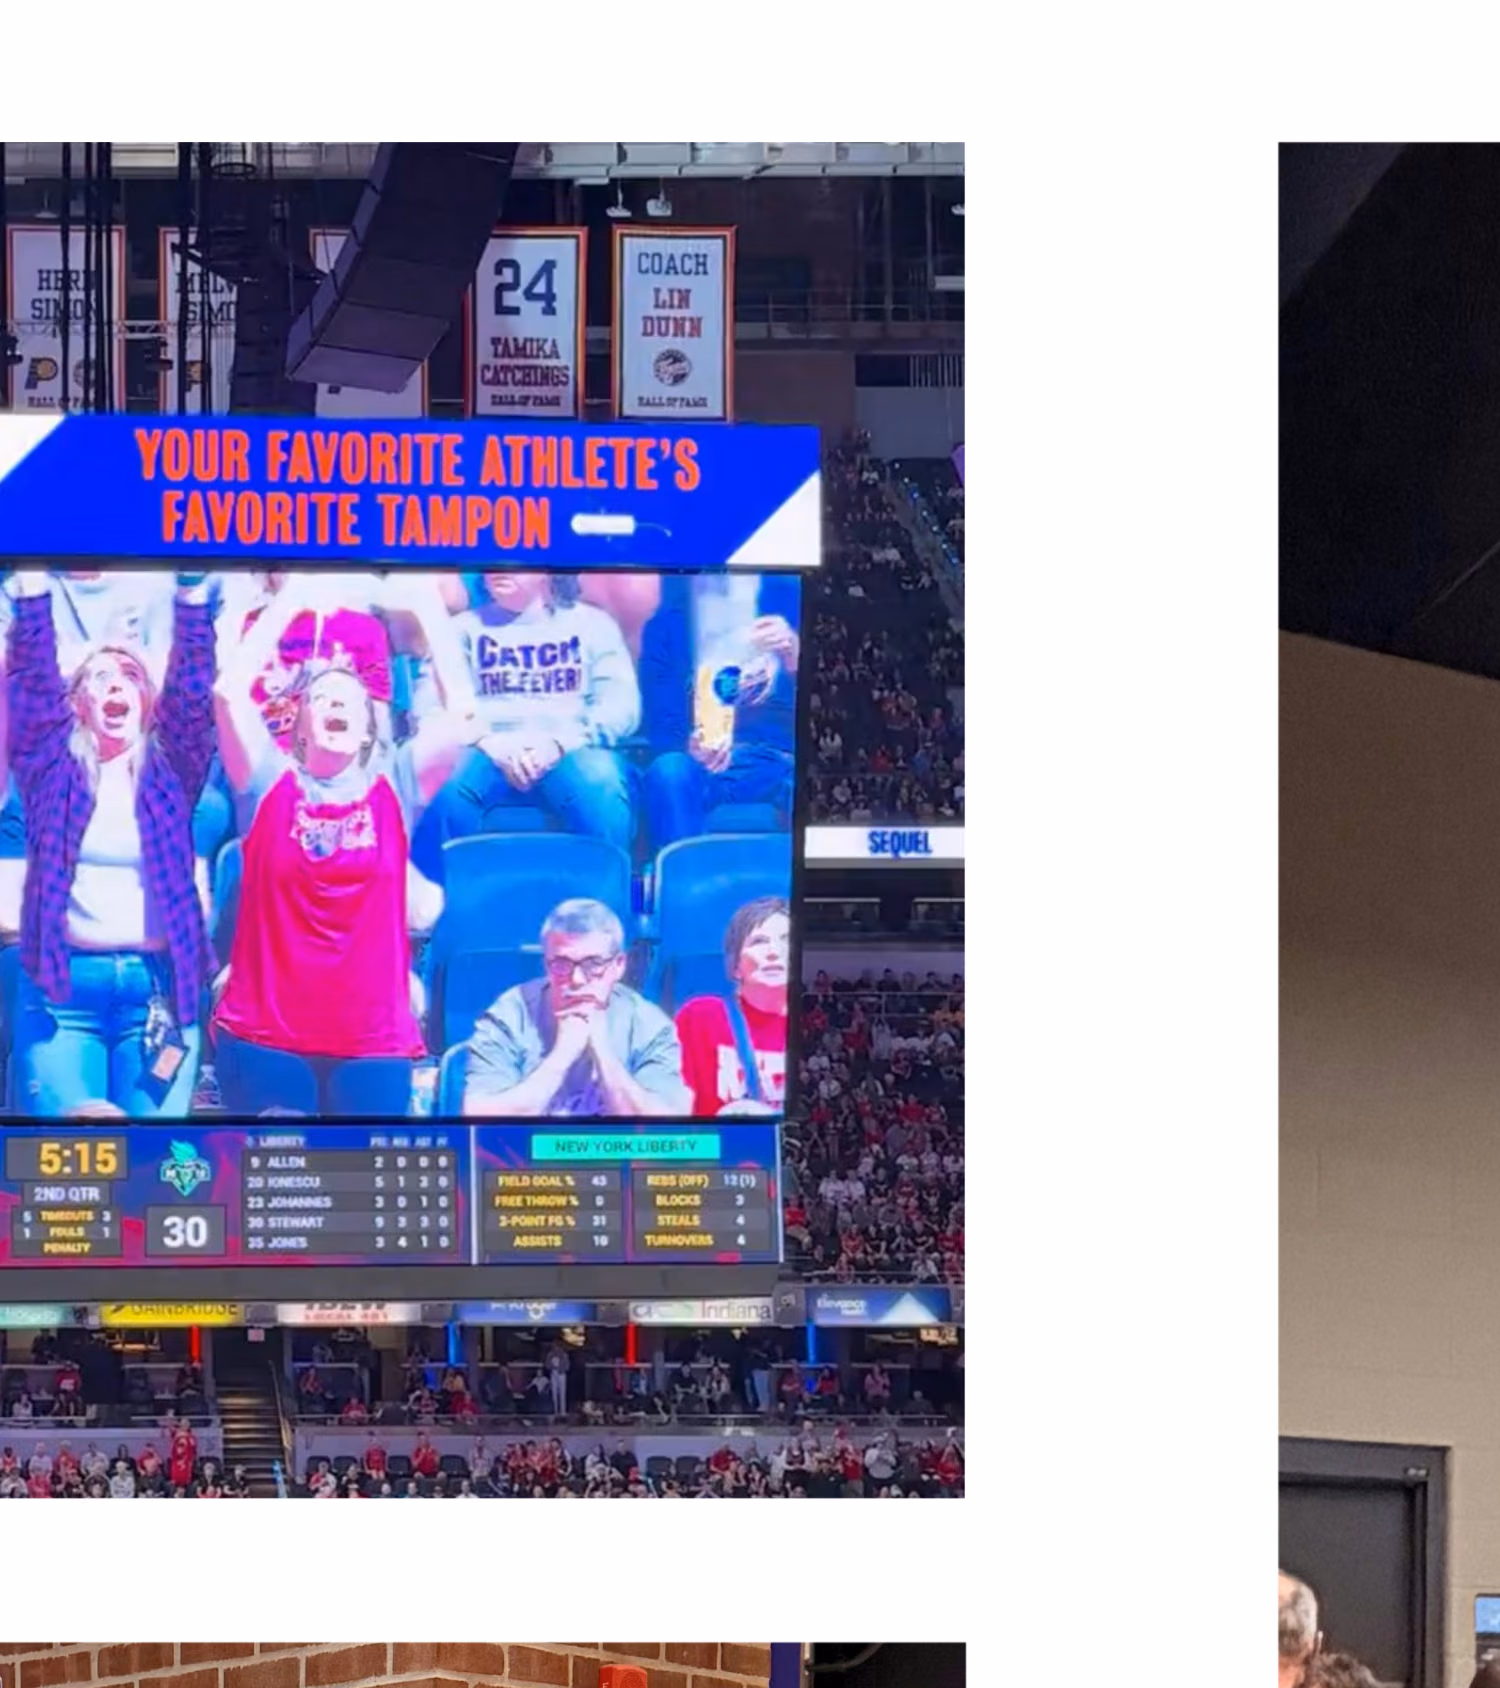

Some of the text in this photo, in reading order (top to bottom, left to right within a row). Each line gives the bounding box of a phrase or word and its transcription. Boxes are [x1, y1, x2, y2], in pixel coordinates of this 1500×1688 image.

[637, 252, 709, 276] COACH
[494, 258, 557, 316] 24
[653, 288, 692, 309] LIN
[641, 316, 703, 338] DUNN
[490, 336, 560, 359] TAMIKA
[480, 364, 569, 387] CATCHINGS
[135, 428, 700, 491] YOUR FAVORITE ATHLETE'S
[163, 491, 549, 548] FAVORITE TAMPON
[868, 830, 931, 859] SEQUEL
[555, 1137, 697, 1155] NEW YORK LIBERTY
[39, 1142, 117, 1175] 5:15
[33, 1187, 100, 1203] 2ND QTR
[163, 1216, 208, 1249] 30
